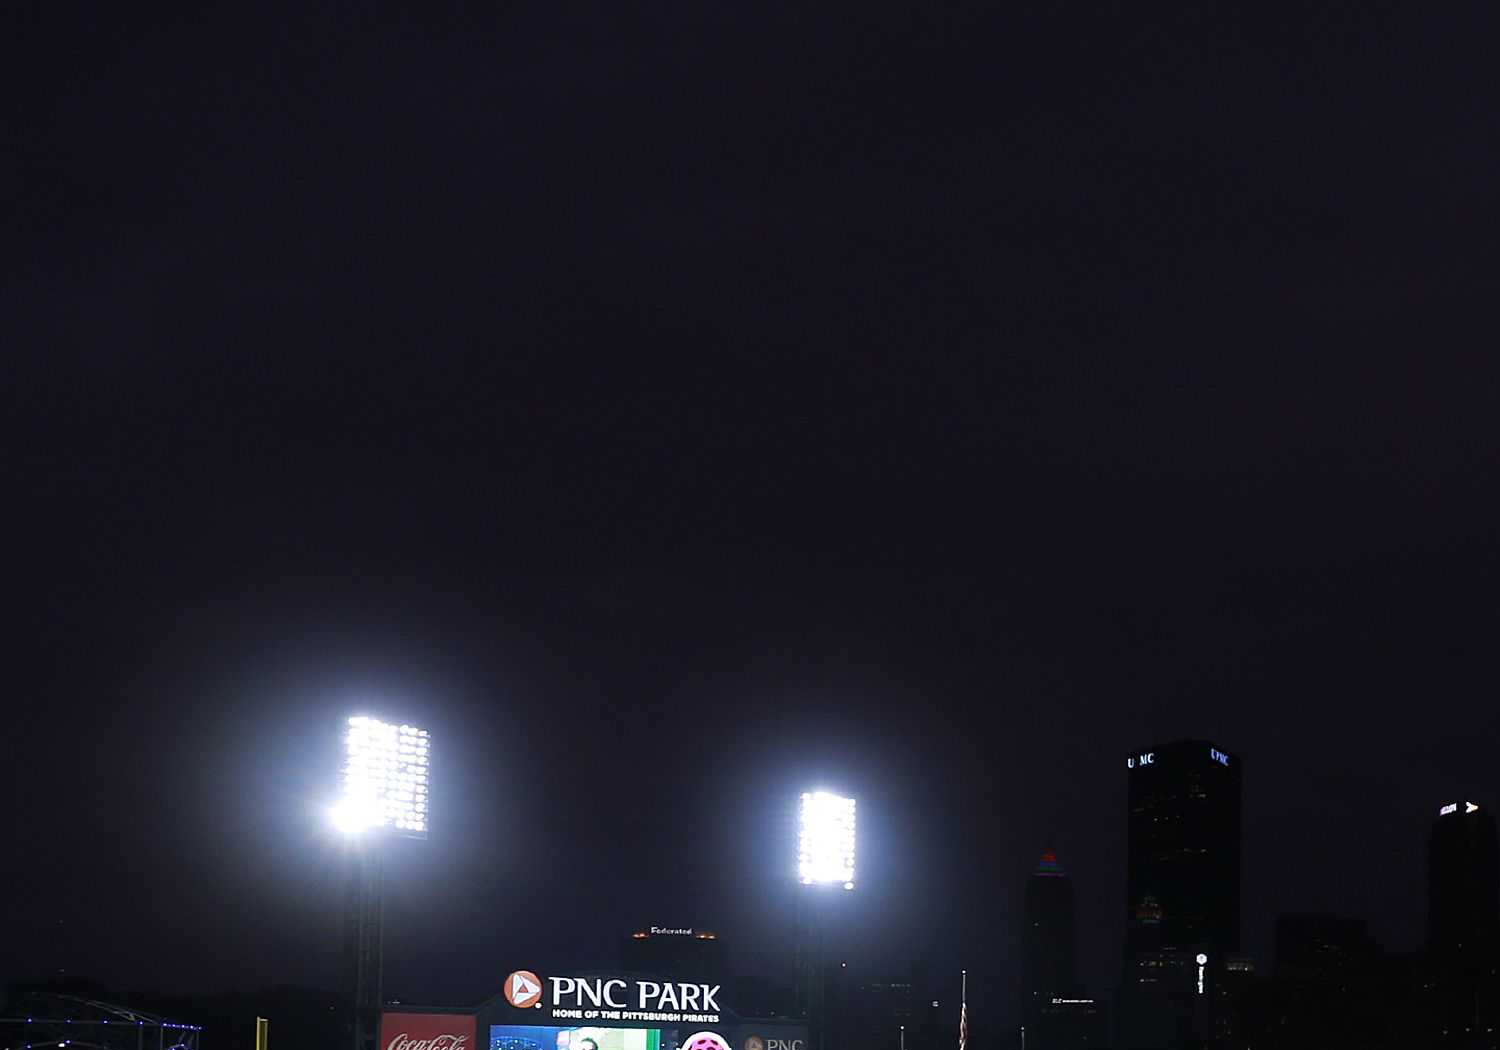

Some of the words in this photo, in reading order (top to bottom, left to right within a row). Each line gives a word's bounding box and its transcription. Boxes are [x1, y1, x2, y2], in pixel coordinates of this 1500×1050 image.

[651, 926, 692, 935] Federated
[548, 976, 627, 1009] PNC
[636, 981, 721, 1011] PARK
[552, 1009, 582, 1019] HOME
[584, 1010, 599, 1019] OF
[601, 1011, 621, 1020] THE
[622, 1012, 681, 1022] PITTSBURGH
[682, 1014, 720, 1023] PIRATES
